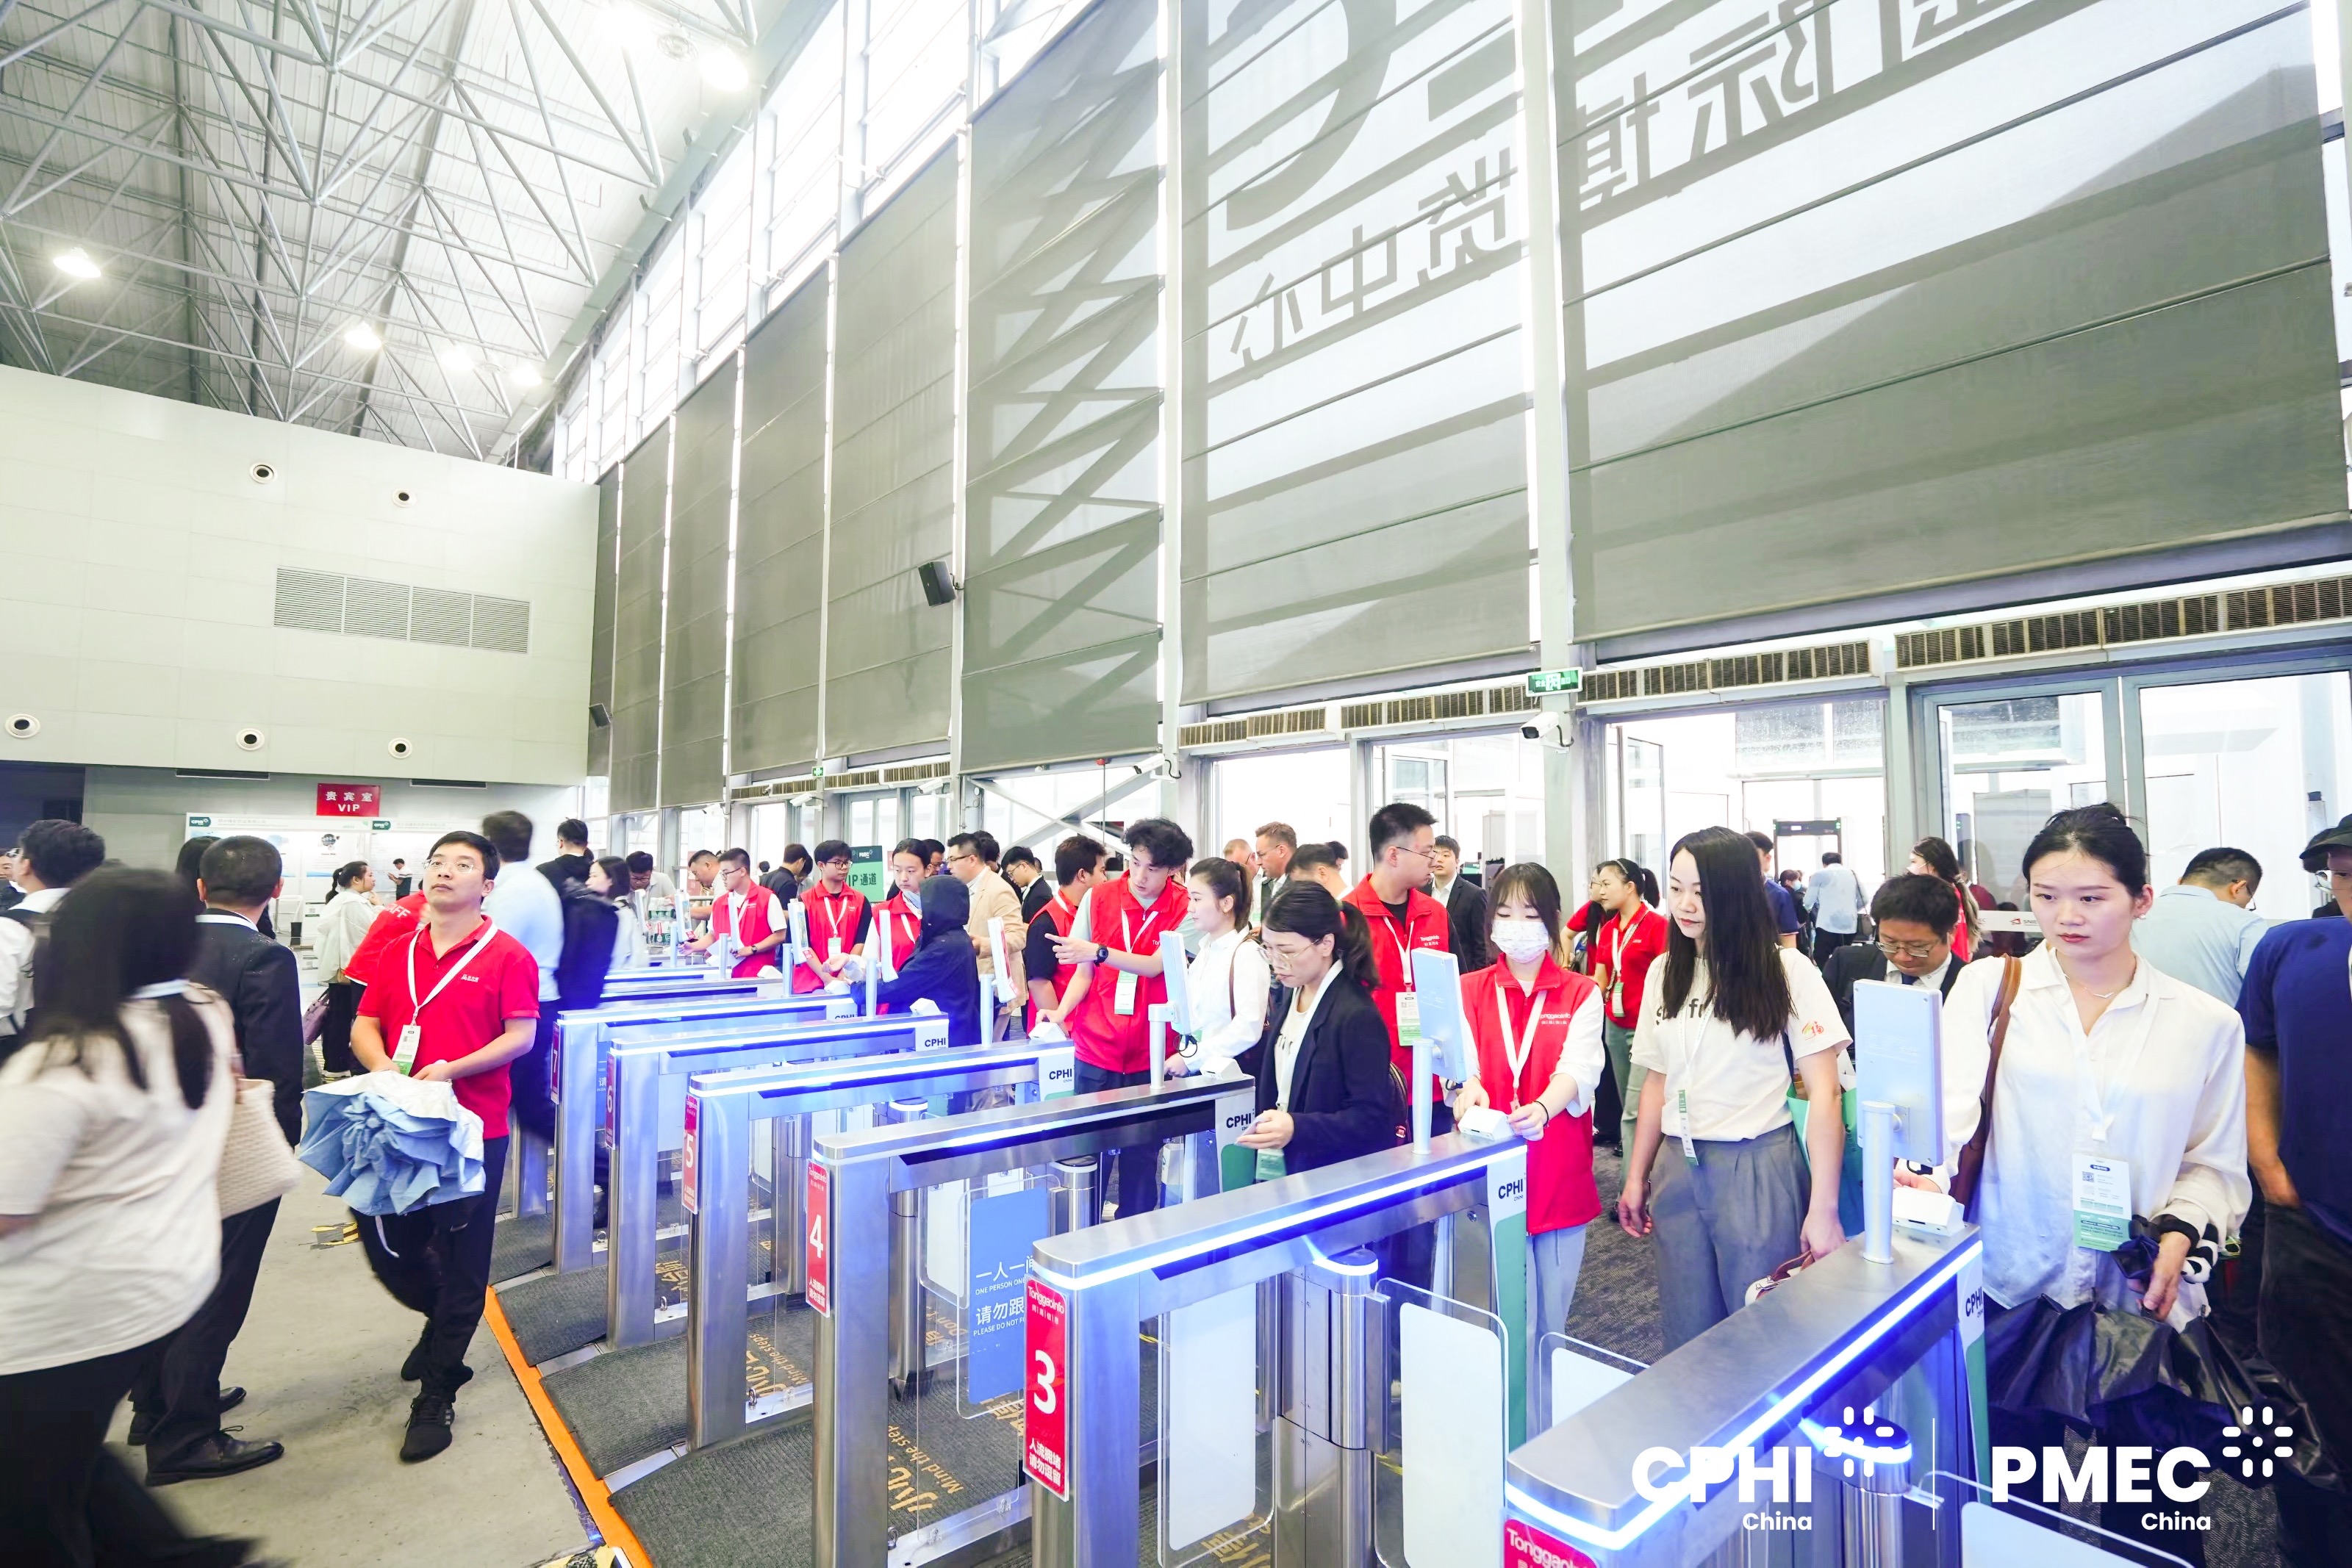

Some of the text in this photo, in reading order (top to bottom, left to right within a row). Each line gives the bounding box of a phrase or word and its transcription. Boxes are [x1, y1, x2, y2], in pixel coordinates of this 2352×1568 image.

[326, 791, 373, 802] 贵宾室
[338, 804, 360, 812] VIP
[861, 873, 877, 886] 通道
[925, 1037, 946, 1047] CPHI
[553, 1049, 558, 1073] 7
[1049, 1068, 1072, 1080] CPHI
[607, 1085, 613, 1113] 6
[1226, 1112, 1252, 1129] CPHI
[686, 1133, 694, 1168] 5
[1498, 1178, 1524, 1199] CPHI
[809, 1214, 824, 1259] 4
[975, 1287, 989, 1296] ONE
[989, 1281, 1013, 1292] PERSON
[1028, 1285, 1065, 1315] TonggaoInfo
[1965, 1286, 1983, 1317] CPHI
[973, 1325, 996, 1337] PLEASE
[996, 1322, 1005, 1331] DO
[1006, 1319, 1019, 1328] NOT
[1033, 1349, 1057, 1414] 3
[888, 1425, 964, 1495] Mind the step
